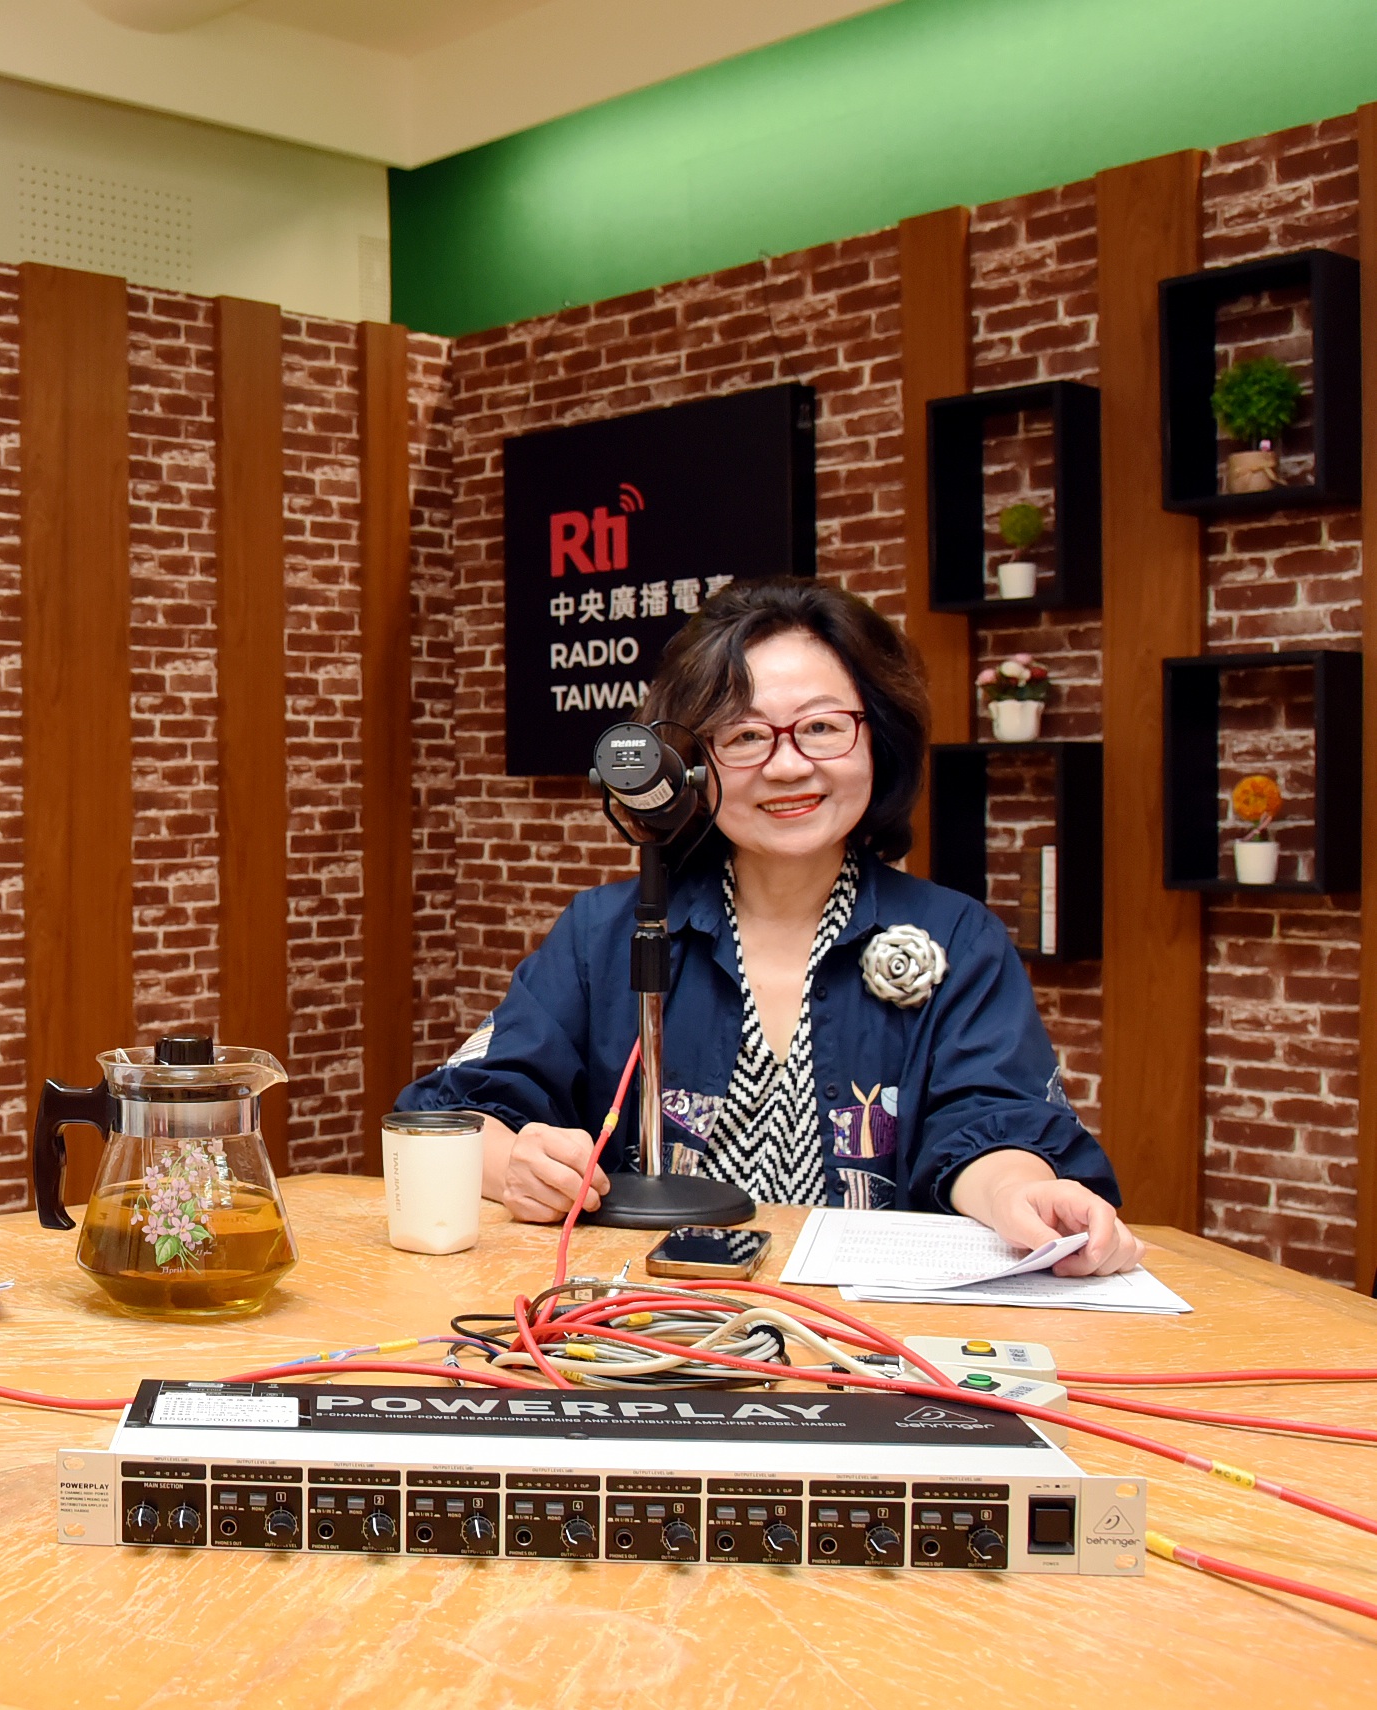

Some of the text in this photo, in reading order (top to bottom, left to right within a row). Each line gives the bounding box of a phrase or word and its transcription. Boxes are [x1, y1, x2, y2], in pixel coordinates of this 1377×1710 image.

[551, 637, 639, 669] RADIO
[610, 739, 647, 748] SHURE
[316, 1395, 830, 1419] POWERPLAY
[895, 1421, 995, 1430] behringer
[60, 1482, 109, 1490] POWERPLAY
[1086, 1536, 1141, 1547] behringer
